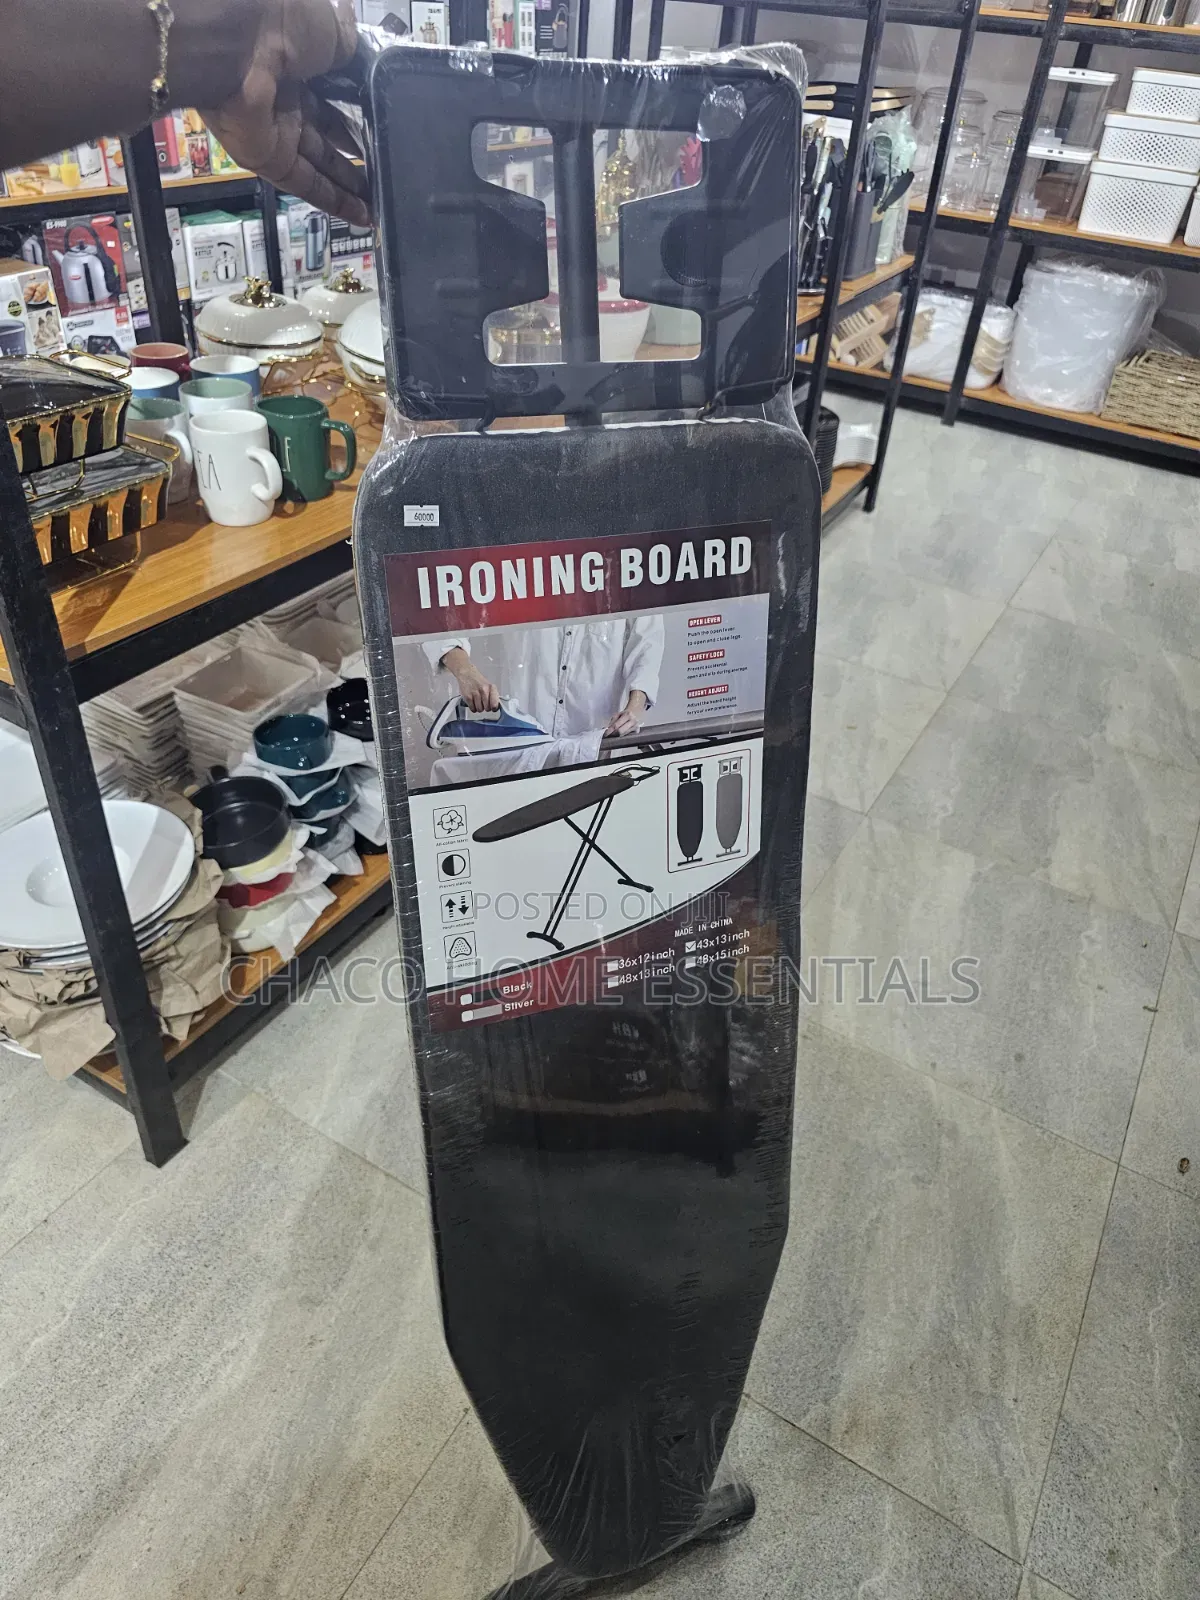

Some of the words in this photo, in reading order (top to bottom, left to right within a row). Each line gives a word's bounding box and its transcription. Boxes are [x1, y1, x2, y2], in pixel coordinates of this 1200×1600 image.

[414, 512, 434, 522] 60000
[417, 551, 604, 609] IRONING
[620, 536, 752, 588] BOARD
[689, 619, 704, 627] OPEN
[704, 616, 721, 625] LEVER
[689, 653, 709, 662] SAFETY
[709, 650, 724, 658] LOCK
[688, 689, 707, 698] HEIGHT
[707, 686, 728, 695] ADJUST
[674, 927, 693, 938] MADE
[698, 924, 707, 932] IN
[710, 918, 733, 929] CHINA
[618, 948, 675, 970] 36x12inch
[696, 929, 750, 950] 43x13inch
[619, 964, 676, 985] 48x13inch
[696, 945, 750, 965] 48x15inch
[502, 981, 533, 994] Black
